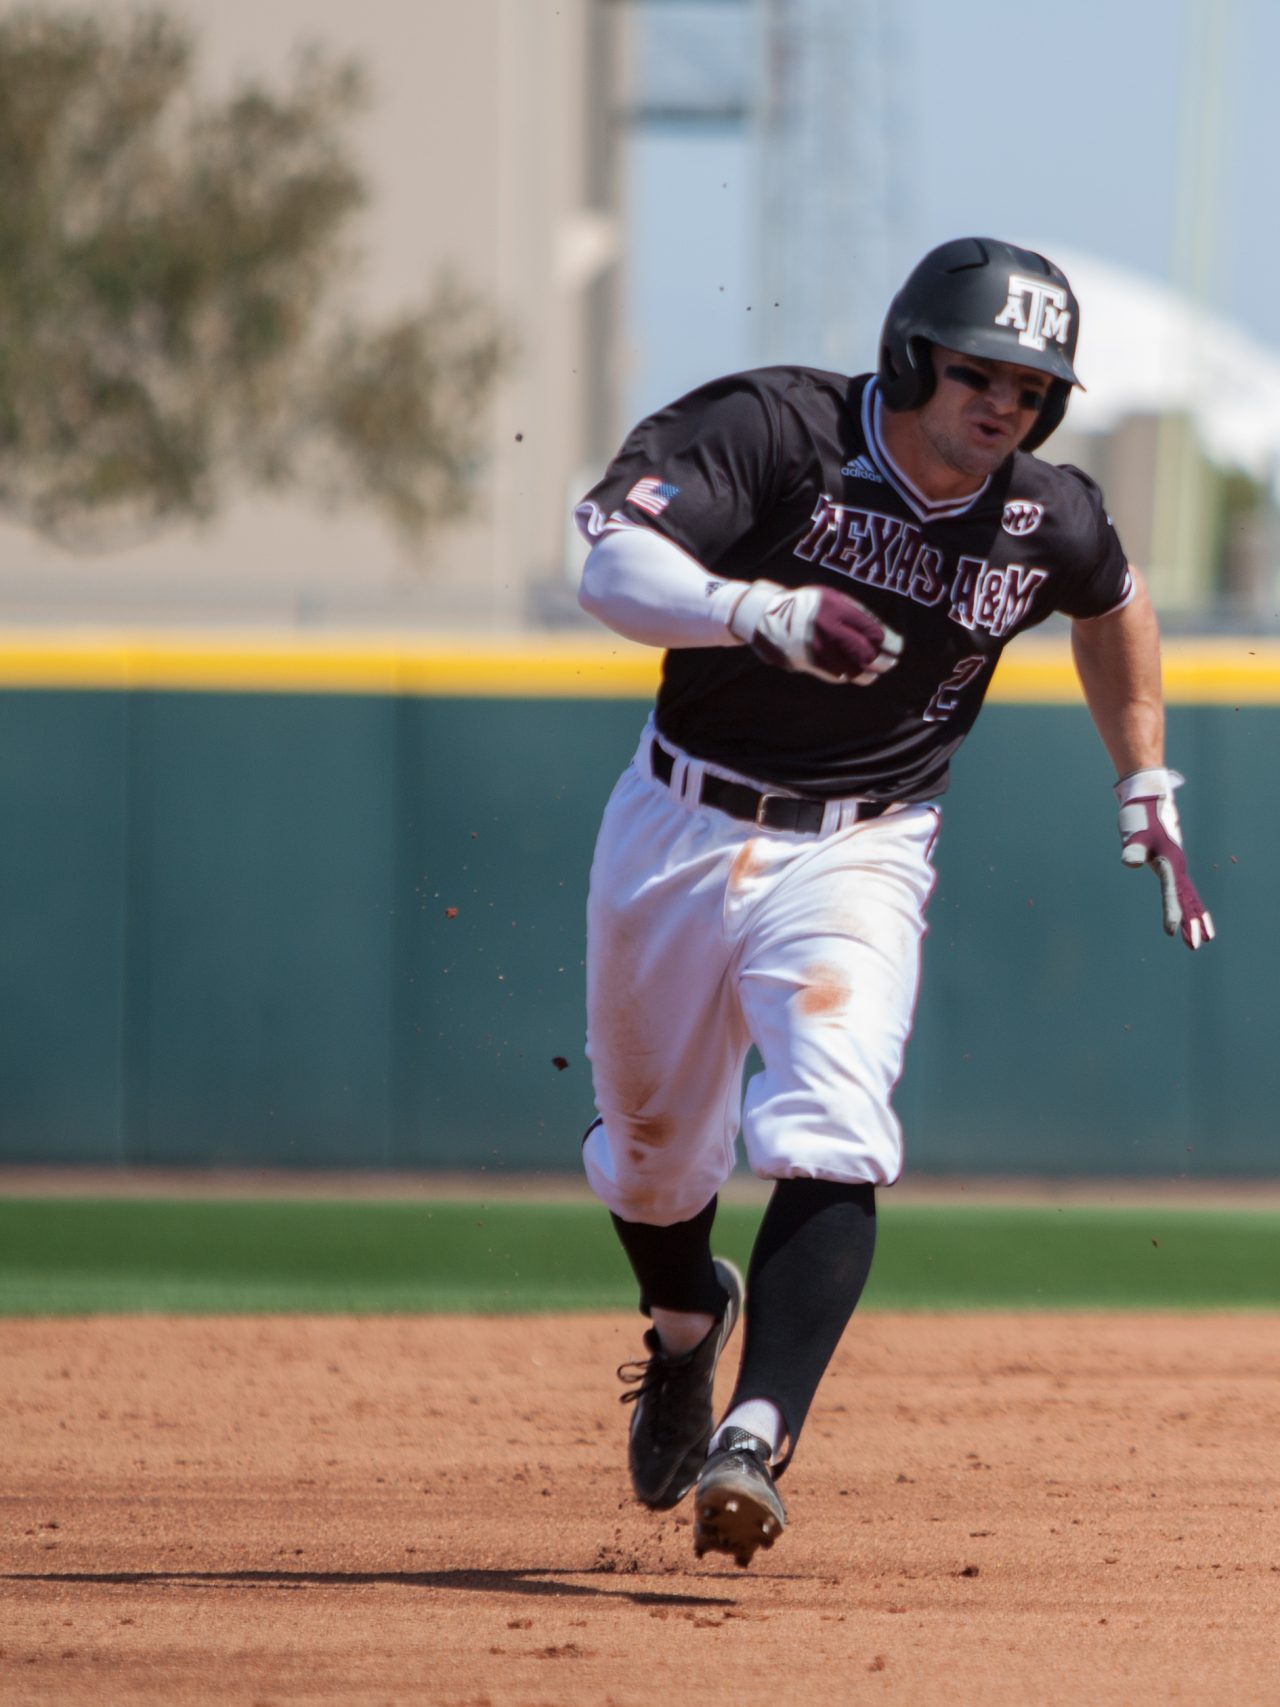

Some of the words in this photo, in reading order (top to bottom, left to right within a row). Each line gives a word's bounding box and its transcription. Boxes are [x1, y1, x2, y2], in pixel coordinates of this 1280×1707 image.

[840, 467, 882, 483] adidas
[793, 494, 947, 607] TEXAS
[948, 556, 1048, 636] A&M
[922, 655, 987, 722] 2
